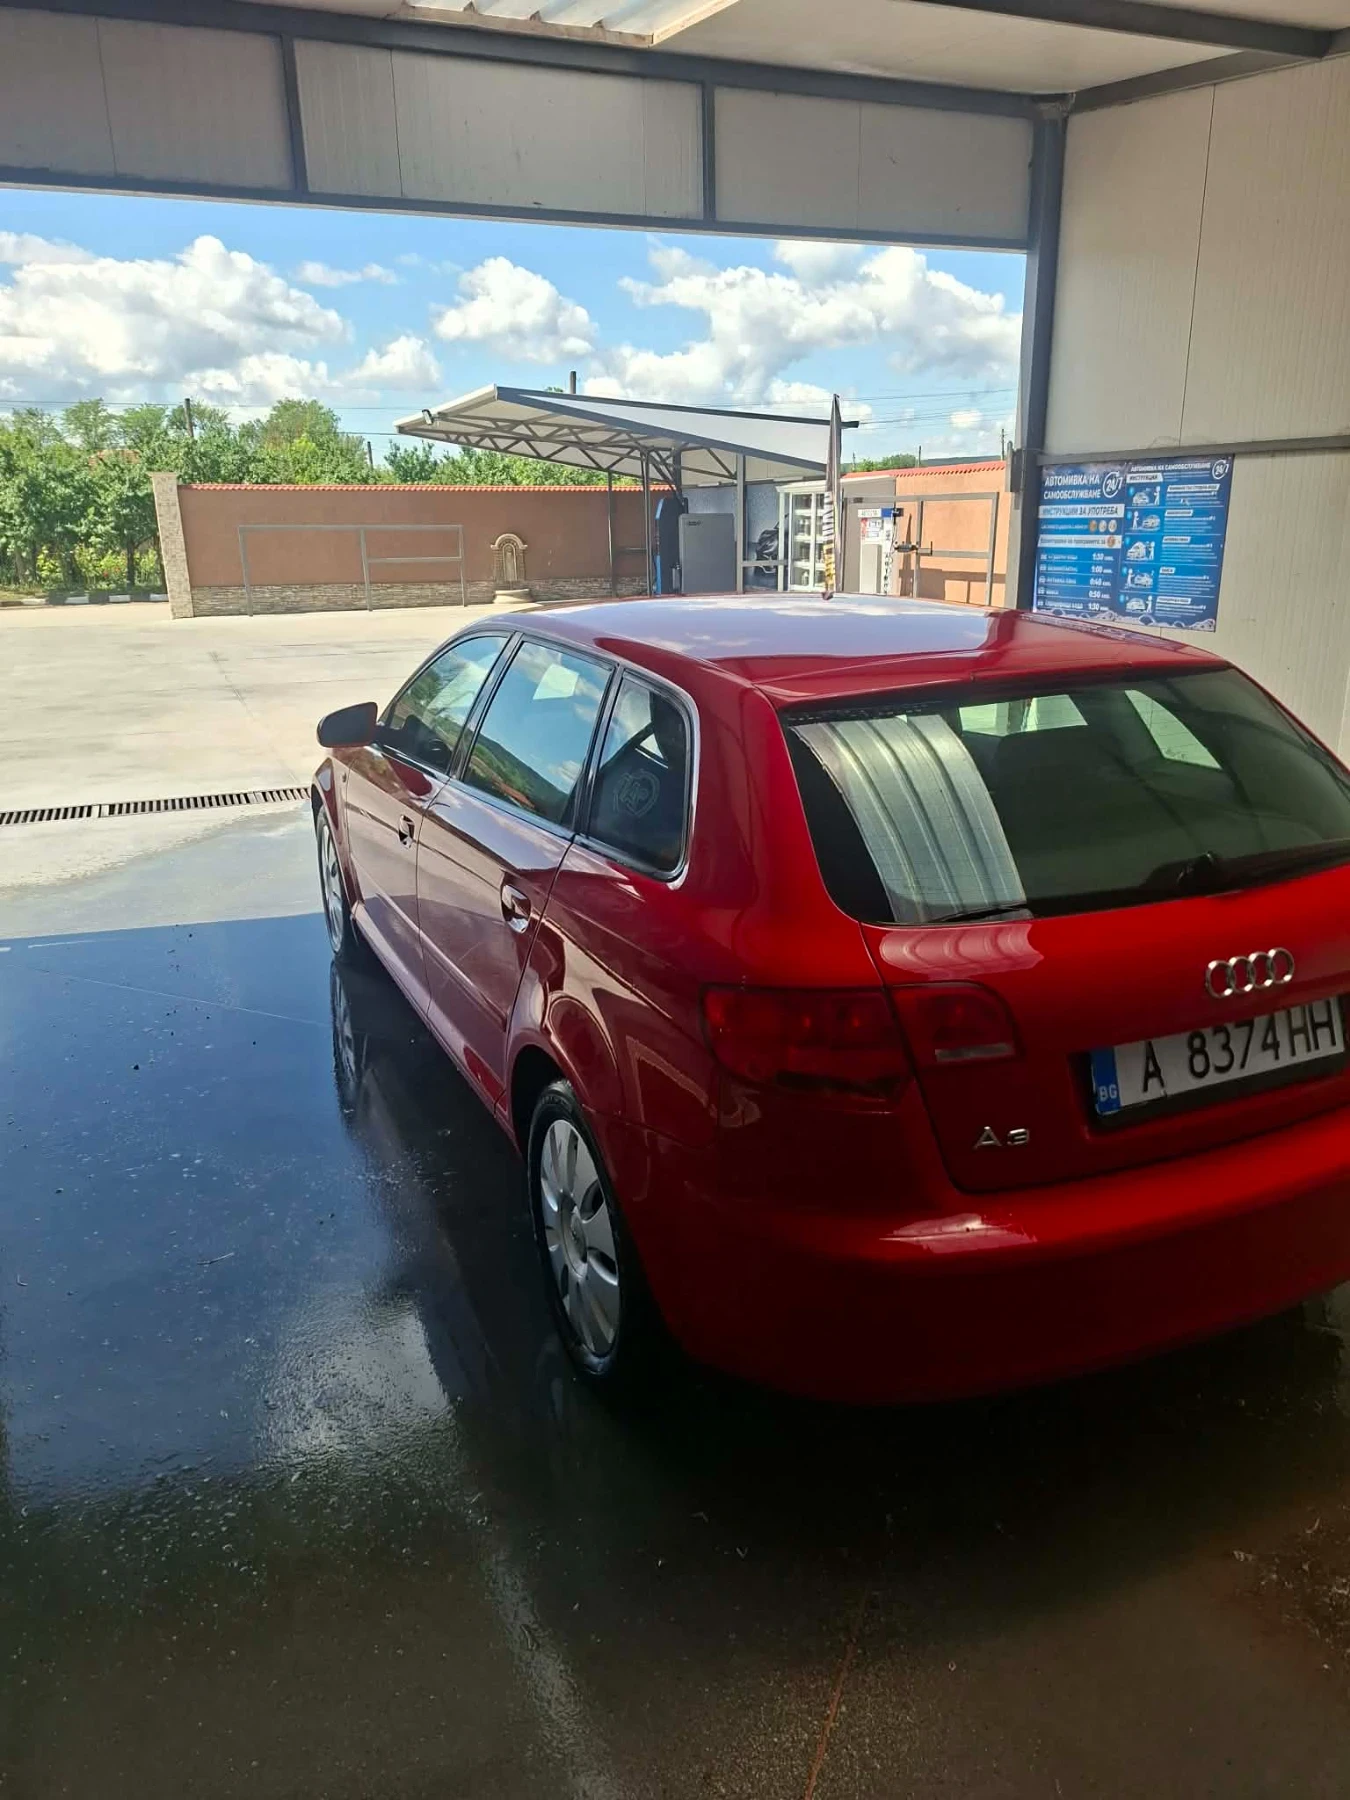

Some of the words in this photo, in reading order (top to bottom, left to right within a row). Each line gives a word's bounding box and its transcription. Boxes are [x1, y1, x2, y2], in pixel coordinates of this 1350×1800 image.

[1044, 475, 1089, 487] АВТОМИВКА
[1089, 474, 1100, 485] НА
[1142, 1040, 1166, 1093] A
[1099, 1084, 1118, 1101] BG
[973, 1126, 1029, 1149] A3
